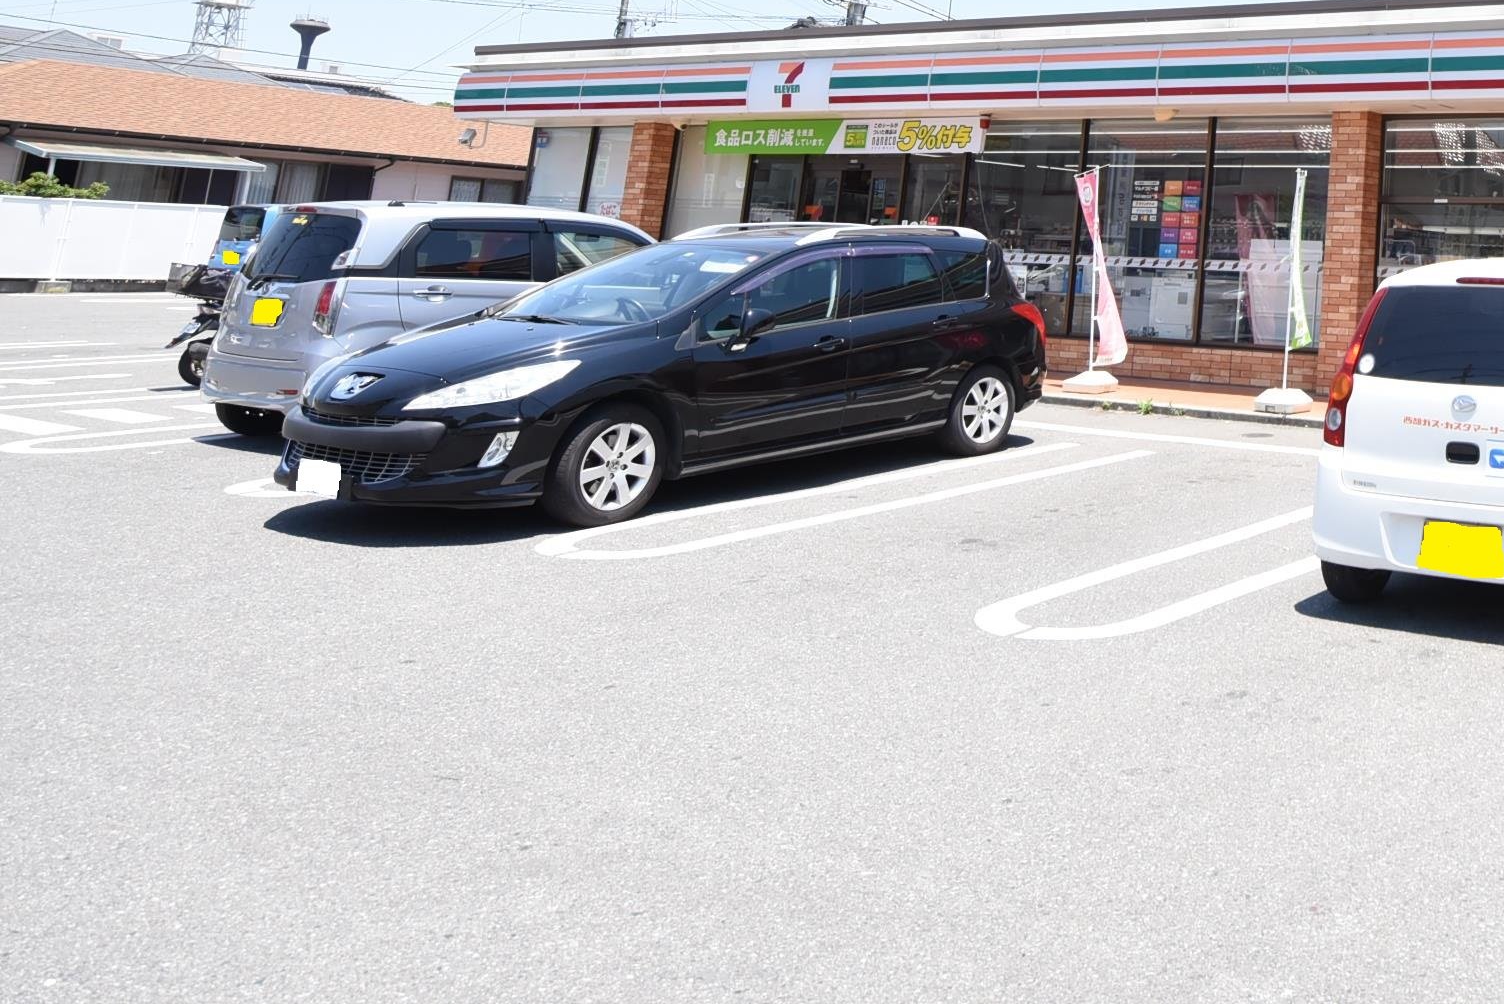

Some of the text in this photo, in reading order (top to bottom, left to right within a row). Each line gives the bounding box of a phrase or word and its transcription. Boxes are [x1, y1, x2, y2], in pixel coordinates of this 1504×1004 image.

[714, 128, 795, 147] 食品ロス削減
[897, 120, 972, 152] 5%付与
